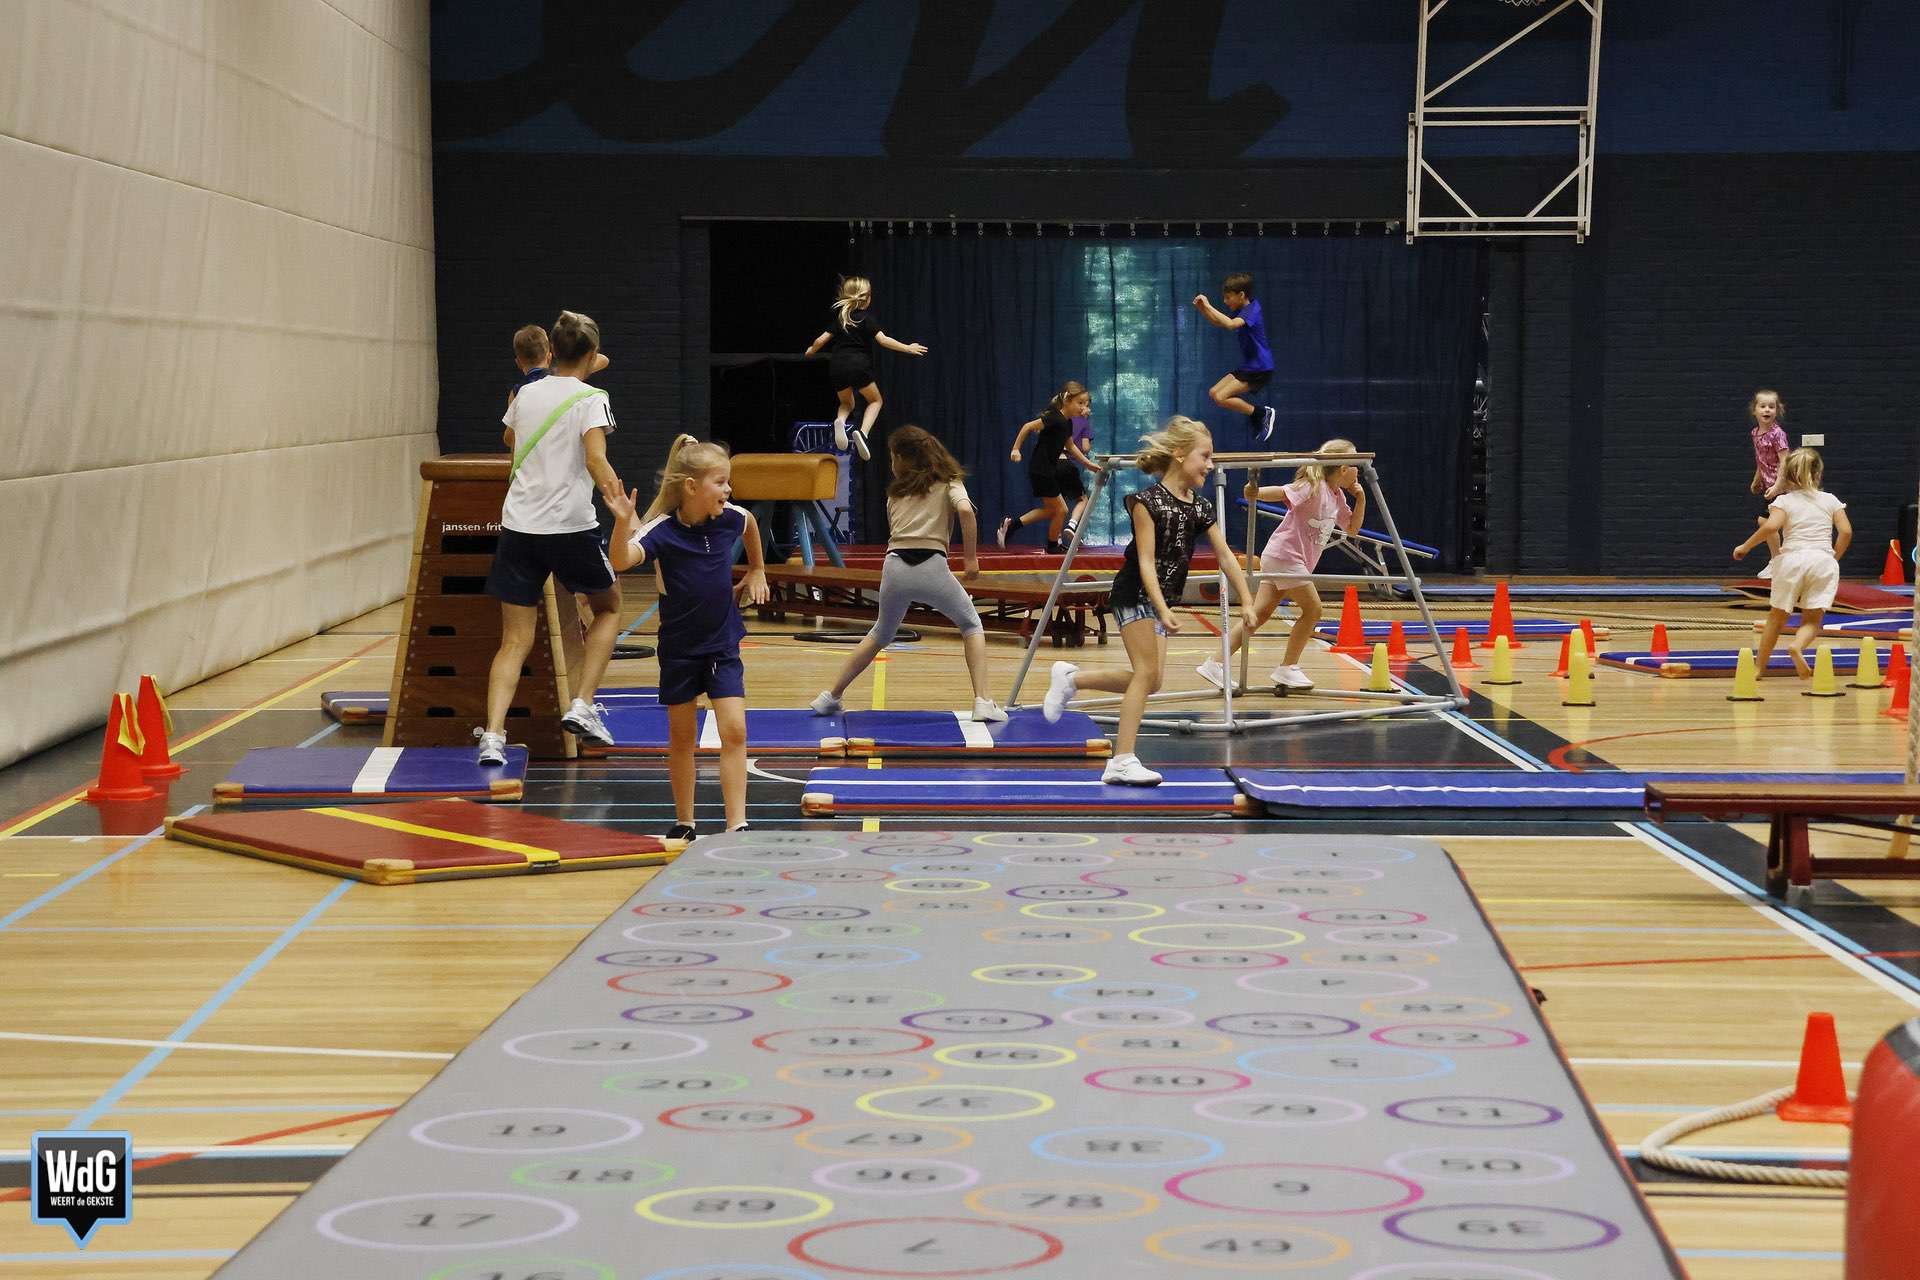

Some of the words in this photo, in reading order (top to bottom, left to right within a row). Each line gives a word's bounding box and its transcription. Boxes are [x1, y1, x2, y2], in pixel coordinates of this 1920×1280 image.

[625, 954, 684, 964] 24
[569, 1039, 636, 1051] 21
[639, 1078, 713, 1090] 20
[1132, 1073, 1207, 1087] 80
[1243, 1103, 1317, 1118] 79
[1435, 1105, 1507, 1119] 51
[486, 1123, 568, 1137] 19
[1438, 1157, 1523, 1173] 50
[553, 1167, 635, 1183] 18
[1019, 1192, 1105, 1209] 78
[404, 1213, 496, 1229] 17
[1203, 1237, 1293, 1255] 49
